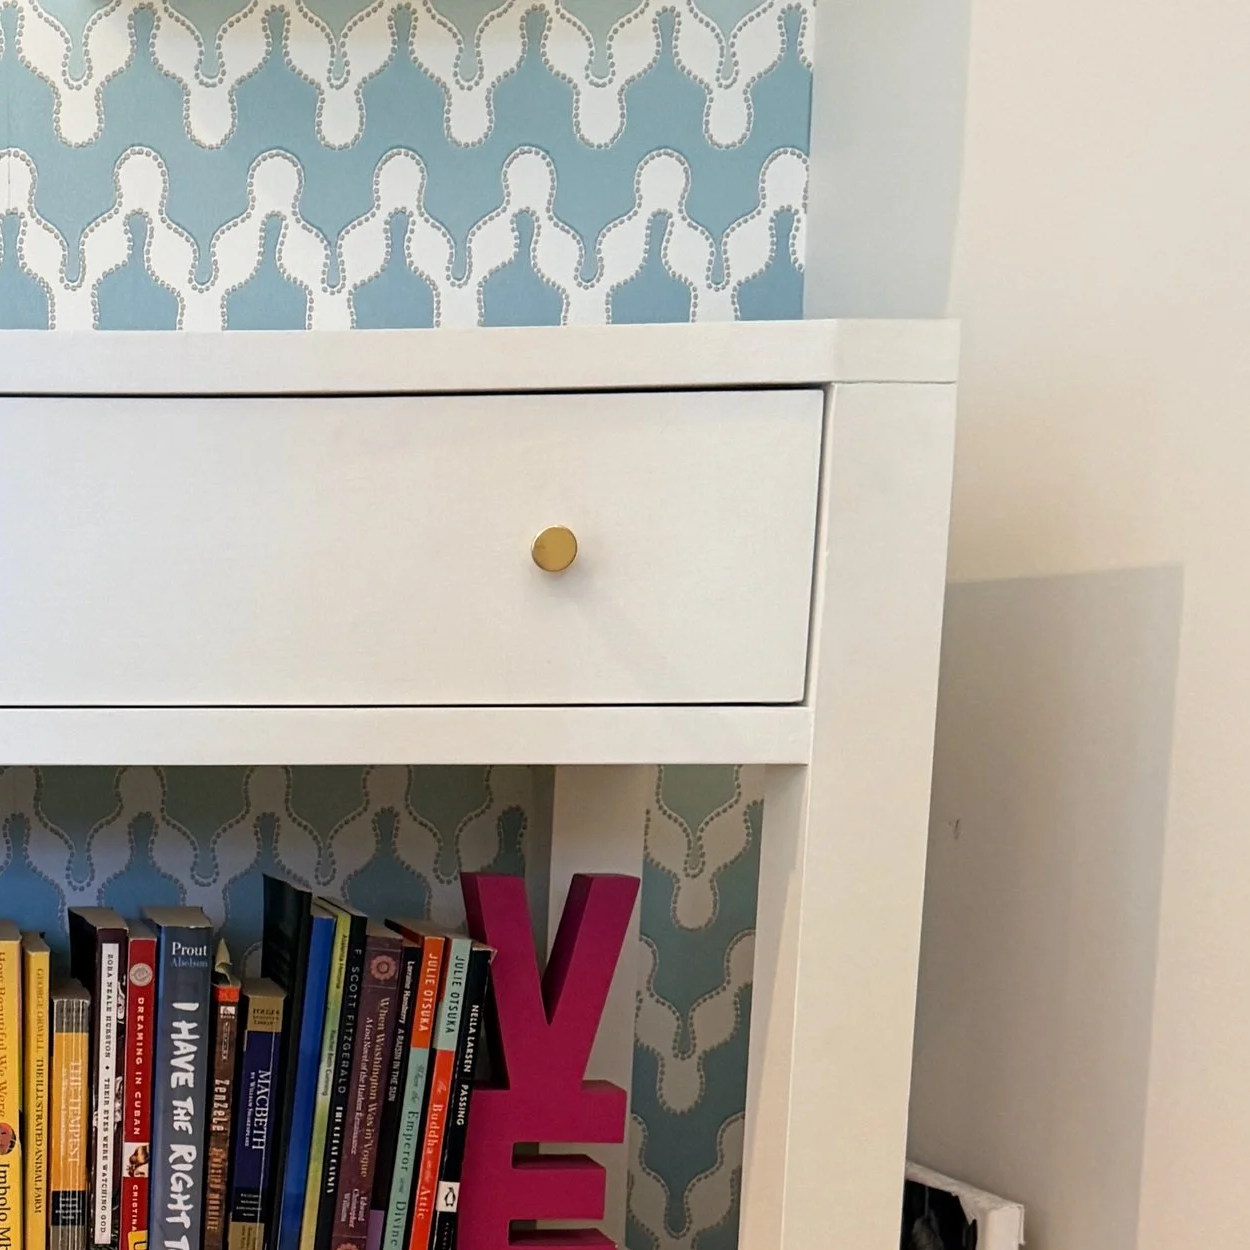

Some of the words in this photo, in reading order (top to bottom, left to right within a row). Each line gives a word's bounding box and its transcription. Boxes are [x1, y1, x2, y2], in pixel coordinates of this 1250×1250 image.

[171, 941, 207, 956] Prout
[171, 958, 208, 967] Abelson
[348, 967, 360, 1008] SCOTT
[404, 961, 415, 989] Lorraine
[425, 953, 438, 985] JULIE
[452, 956, 465, 987] JULIE
[172, 1002, 199, 1011] I
[377, 997, 390, 1030] When
[418, 990, 433, 1032] OTSUKA
[445, 992, 460, 1033] OTSUKA
[468, 1004, 479, 1034] NELLA
[135, 997, 144, 1065] DREAMING
[170, 1020, 200, 1089] HAVE
[338, 1015, 354, 1094] FITZGERALD
[369, 1033, 386, 1100] Washington
[464, 1036, 476, 1073] LARSEN
[135, 1072, 142, 1084] IN
[391, 1070, 399, 1085] THE
[35, 1079, 44, 1146] ILLUSTRATED
[133, 1091, 142, 1135] CUBAN
[172, 1096, 194, 1135] THE
[252, 1069, 272, 1150] MACBETH
[366, 1102, 378, 1127] Was
[456, 1084, 469, 1126] PASSING
[401, 1111, 419, 1171] Emperor
[427, 1103, 443, 1154] Buddha
[34, 1147, 43, 1185] ANIMAL
[360, 1140, 374, 1178] Vogue
[166, 1144, 197, 1229] RIGHT
[417, 1186, 431, 1219] Attic
[391, 1200, 407, 1246] Divine
